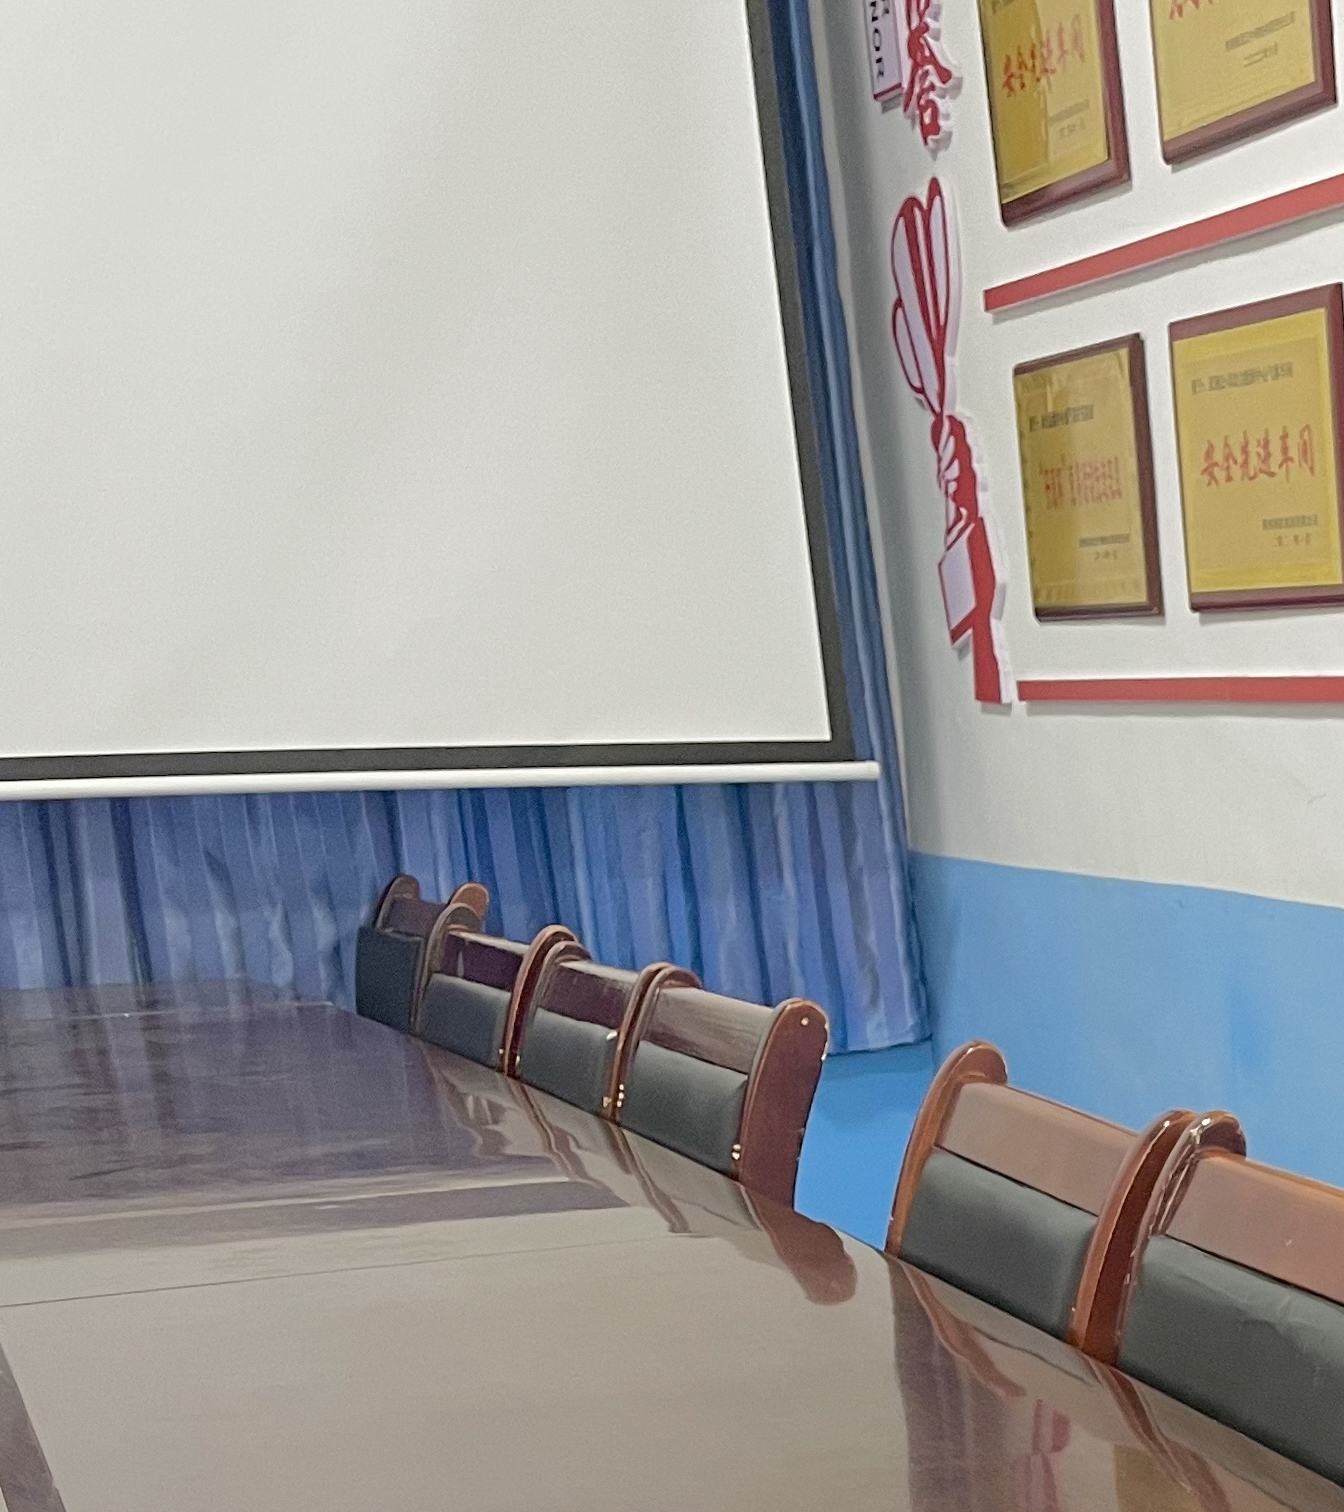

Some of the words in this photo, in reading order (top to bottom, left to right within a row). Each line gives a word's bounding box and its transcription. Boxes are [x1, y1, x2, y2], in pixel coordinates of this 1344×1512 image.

[1200, 424, 1316, 488] 安全先进车间
